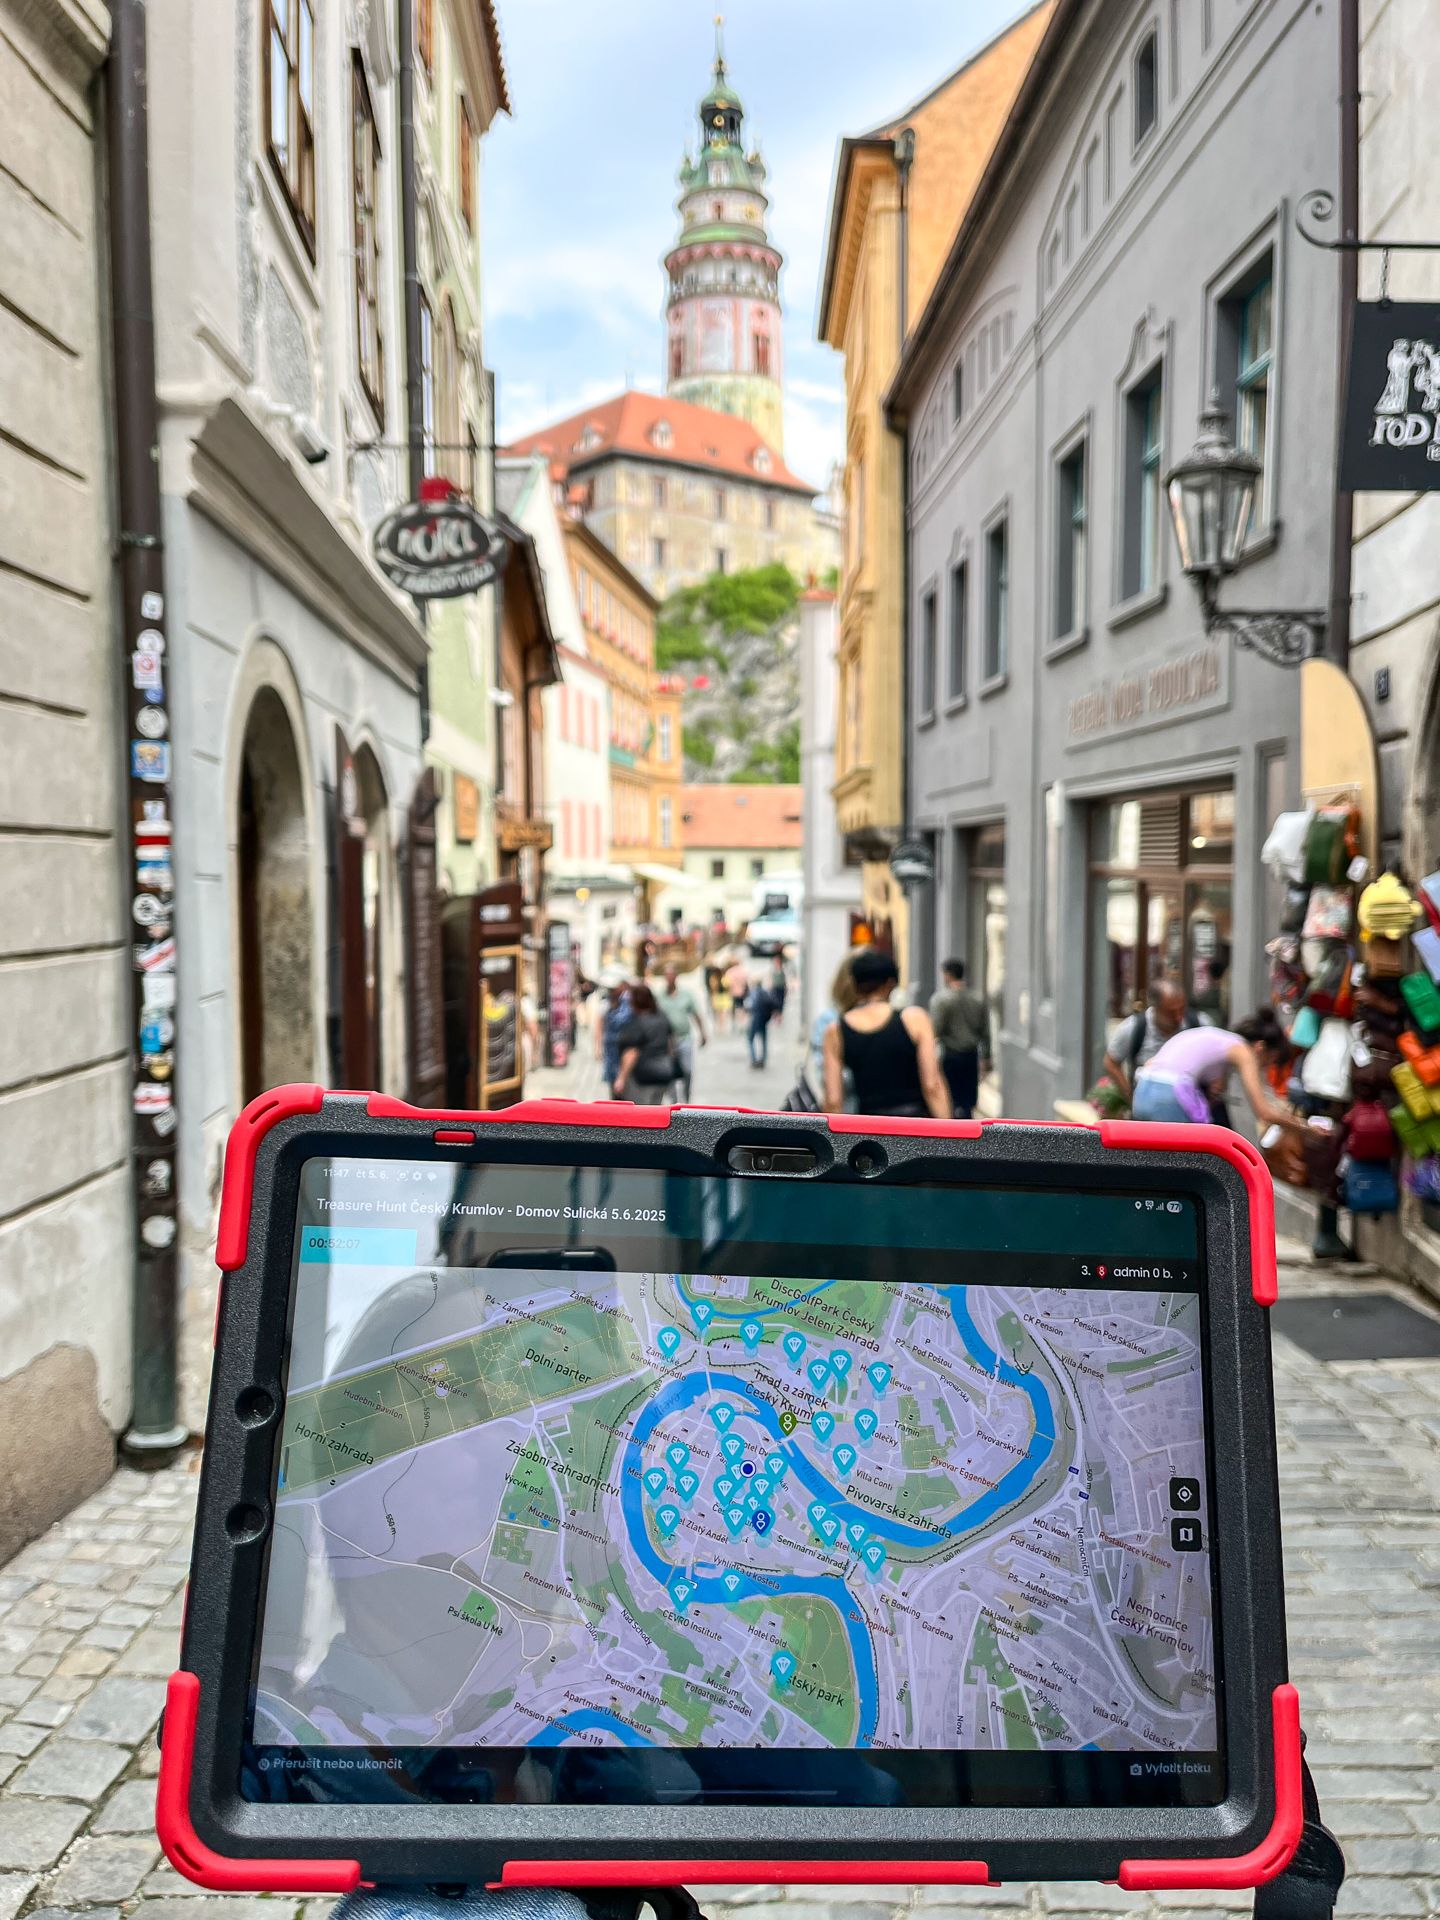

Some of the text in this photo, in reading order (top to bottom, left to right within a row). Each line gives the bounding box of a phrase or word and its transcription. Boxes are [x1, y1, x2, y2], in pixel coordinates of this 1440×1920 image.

[323, 1168, 350, 1178] 11:47
[317, 1198, 666, 1222] Treasure Hunt Český Krumlov Domov Sulická 5.6.2025
[1170, 1203, 1180, 1211] 77
[309, 1237, 360, 1249] 00:52:07
[1081, 1265, 1091, 1276] 3.
[1113, 1267, 1173, 1279] admin 0 b.
[570, 1290, 602, 1311] Zámecká
[771, 1279, 875, 1333] DiscGolfPark Český
[924, 1300, 951, 1319] Alžběty
[485, 1294, 567, 1336] P4 Zámecká zahrada
[753, 1289, 880, 1352] Krumlov Jelení Zahrada
[1023, 1314, 1064, 1337] CK Pension
[1073, 1318, 1148, 1356] Pension Pod Skalkou
[525, 1348, 592, 1384] Dolní parter
[630, 1352, 687, 1381] barokní divadlo
[895, 1337, 953, 1370] P2 Pod Poštou
[1061, 1354, 1105, 1380] Villa Agnese
[970, 1365, 988, 1378] most
[989, 1372, 996, 1380] U
[437, 1380, 468, 1399] Bellarie
[745, 1382, 780, 1408] Český
[754, 1368, 829, 1410] hrad a zámek
[940, 1374, 970, 1404] Pivovarská
[343, 1388, 404, 1420] Hudební pavilon
[294, 1422, 374, 1466] Horní zahrada
[594, 1418, 657, 1452] Pension Labyrint
[650, 1426, 674, 1444] Hotel
[976, 1430, 1033, 1460] Pivovarský dvůr
[505, 1440, 622, 1497] Zásobní zahradnictví
[856, 1470, 894, 1492] Villa Conti
[930, 1454, 1000, 1492] Pivovar Eggenberg
[504, 1472, 544, 1497] Výcvik psů
[386, 1514, 395, 1528] 550
[528, 1505, 608, 1546] Muzeum zahradnictví
[846, 1484, 952, 1540] Pivovarská zahrada
[686, 1520, 706, 1538] Zlatý
[706, 1530, 729, 1544] Anděl
[1032, 1518, 1070, 1540] MOL wash
[776, 1534, 817, 1559] Seminární
[816, 1553, 848, 1572] zahrada
[1010, 1536, 1061, 1564] Pod nádražím
[1076, 1526, 1090, 1578] Nemocniční
[1099, 1532, 1172, 1569] Restaurace Vrátnice
[713, 1554, 746, 1576] Vyhlídka
[752, 1574, 780, 1590] kostela
[522, 1571, 605, 1614] Penzion Villa Johanna
[1007, 1572, 1070, 1606] P5 Autobusové
[446, 1606, 504, 1636] Psí škola U Mě
[880, 1594, 921, 1620] Ex Bowling
[1126, 1596, 1188, 1632] Nemocnice
[620, 1608, 652, 1647] Nad Schody
[662, 1610, 722, 1642] CEVRO Institute
[748, 1624, 788, 1648] Hotel Gold
[849, 1610, 895, 1637] Bar Topinka
[921, 1620, 954, 1642] Gardena
[1012, 1620, 1034, 1636] škola
[1110, 1606, 1194, 1655] Český Krumlov
[1008, 1662, 1063, 1694] Pension Maate
[1050, 1660, 1078, 1685] Kaplická
[604, 1673, 668, 1707] Pension Athanor
[706, 1677, 740, 1698] Museum
[816, 1689, 844, 1707] park
[563, 1690, 652, 1734] Apartmán U Muzikanta
[728, 1700, 752, 1717] Seidel
[990, 1700, 1021, 1720] Penzion
[1055, 1728, 1073, 1744] dům
[1092, 1704, 1130, 1728] Villa Oliva
[514, 1702, 545, 1723] Pension
[588, 1734, 604, 1746] 119
[1142, 1728, 1160, 1744] Účto
[273, 1758, 402, 1770] Přerušit nebo ukončit
[1145, 1762, 1210, 1776] Vyfotit fotku
